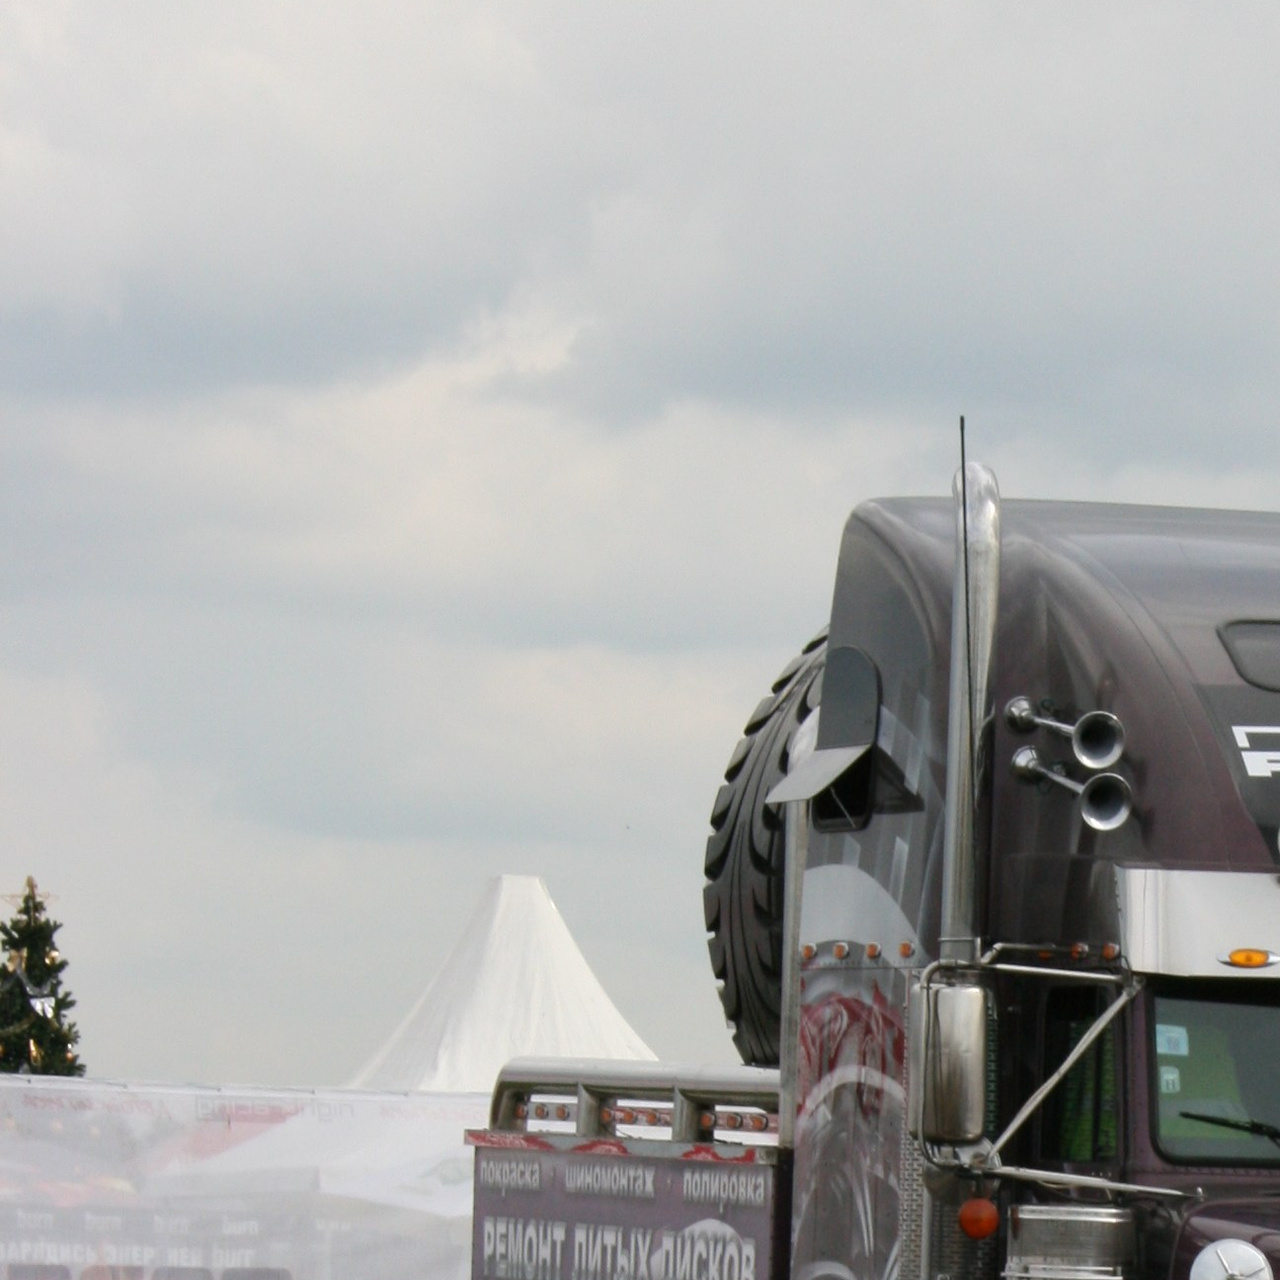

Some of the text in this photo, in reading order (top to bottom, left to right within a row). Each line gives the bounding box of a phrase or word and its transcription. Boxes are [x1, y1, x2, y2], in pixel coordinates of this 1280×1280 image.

[480, 1160, 765, 1213] покраска шиномонтаж полировка
